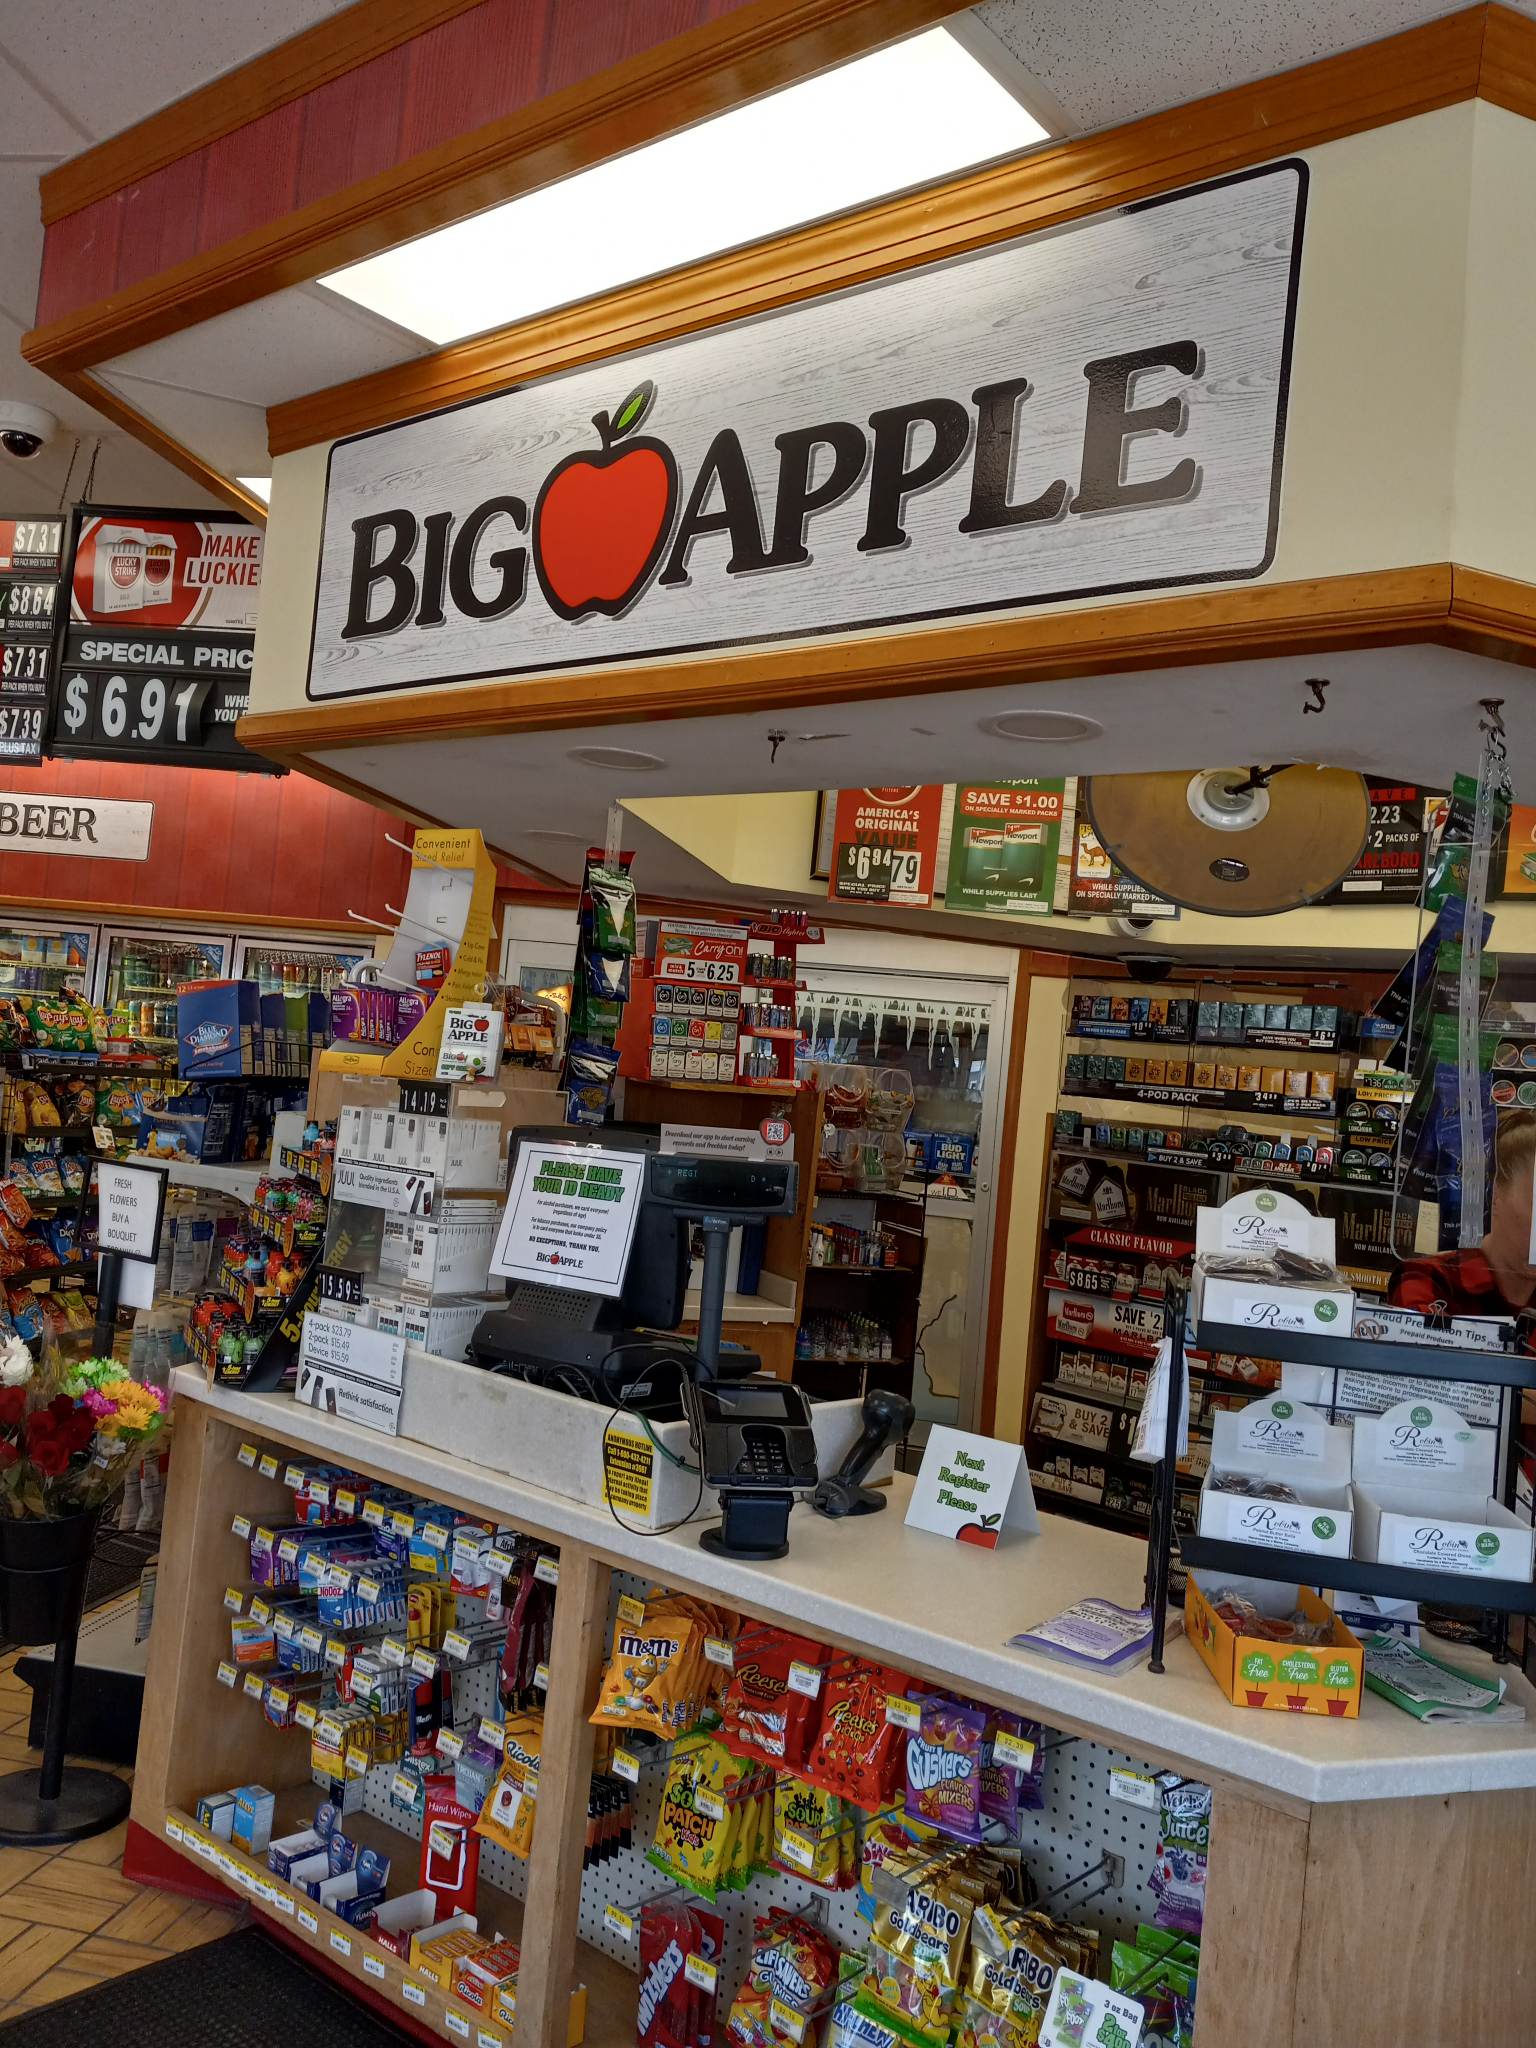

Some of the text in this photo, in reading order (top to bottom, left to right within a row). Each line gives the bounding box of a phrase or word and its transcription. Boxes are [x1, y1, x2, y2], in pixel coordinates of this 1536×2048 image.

[341, 340, 1204, 643] BIG APPLE
[15, 522, 61, 553] $7.31
[203, 535, 261, 559] MAKE
[116, 556, 137, 567] LUCKY
[115, 566, 137, 577] STRIKE
[186, 561, 262, 586] LUCKIE
[9, 585, 55, 615] $8.64
[2, 648, 48, 678] $7.31
[80, 641, 252, 670] SPECIAL PRIC
[64, 674, 198, 742] $6.91
[224, 695, 249, 708] WHE
[20, 742, 36, 754] TAX
[967, 791, 1058, 809] SAVE $1.00
[857, 807, 920, 820] AMERICA'S
[976, 806, 1009, 814] SPECIALLY
[855, 818, 919, 832] ORIGINAL
[415, 837, 471, 850] Convenient
[855, 832, 918, 849] VALUE
[1385, 833, 1409, 843] PACKS
[440, 852, 465, 862] Relief
[963, 888, 1038, 899] WHILE SUPPLIES LAST
[1076, 890, 1150, 901] ON SPECIALLY MARKED
[1092, 883, 1113, 891] WHILE
[694, 940, 726, 960] Carry
[687, 961, 696, 978] 5
[449, 1017, 473, 1030] BIG
[447, 1029, 489, 1043] APPLE
[1137, 1089, 1199, 1103] 4-POD PACK
[936, 1150, 966, 1160] LIGHT
[941, 1143, 963, 1152] BUD
[1158, 1154, 1173, 1163] BUY
[1173, 1155, 1179, 1163] 2
[1179, 1156, 1185, 1164] &
[1185, 1157, 1203, 1166] SAVE
[540, 1160, 624, 1185] PLEASE HAVE
[114, 1177, 132, 1190] FRESH
[532, 1176, 626, 1203] YOUR ID READY
[109, 1194, 138, 1207] FLOWERS
[112, 1212, 130, 1224] BUY A
[1232, 1215, 1281, 1236] Robin
[107, 1228, 137, 1242] BOUQUET
[1090, 1230, 1174, 1255] CLASSIC FLAVOR
[1353, 1242, 1367, 1250] NOW
[536, 1252, 584, 1269] BIG APPLE
[1114, 1305, 1146, 1327] SAVE
[1244, 1302, 1297, 1328] Robin
[1373, 1311, 1487, 1342] Fraud Tips
[1400, 1327, 1425, 1341] Prepaid
[308, 1342, 329, 1358] Device
[338, 1388, 360, 1403] Rethink
[1341, 1390, 1376, 1403] incident of
[1343, 1383, 1366, 1394] Report
[1340, 1396, 1382, 1412] transactions
[1074, 1408, 1108, 1426] BUY 2
[1068, 1418, 1111, 1438] & SAVE
[1249, 1419, 1298, 1440] Robin
[1389, 1425, 1436, 1448] Robin
[608, 1433, 634, 1447] ANONYMOUS
[954, 1450, 986, 1472] Next
[937, 1466, 991, 1493] Register
[936, 1488, 978, 1513] Please
[1240, 1505, 1293, 1531] Robin
[1408, 1527, 1460, 1551] Robin
[1247, 1663, 1269, 1678] Free
[1282, 1659, 1317, 1670] CHOLESTEROL
[1330, 1665, 1349, 1673] GLUTEN
[1287, 1667, 1309, 1681] Free
[1328, 1672, 1349, 1685] Free
[917, 1736, 937, 1750] FRUIT
[940, 1778, 971, 1795] FLAVOR
[938, 1791, 976, 1812] MIXERS
[428, 1801, 472, 1820] Hand Wipes
[786, 1801, 824, 1827] SOUR
[664, 1801, 717, 1841] PATCH
[907, 1889, 961, 1937] ARIBO
[889, 1911, 951, 1955] Goldbears
[377, 1936, 398, 1953] HALLS
[418, 1966, 440, 1984] HALLS
[457, 1982, 484, 2006] Ricola
[1104, 1999, 1139, 2024] 3 oz Bag
[1104, 2012, 1117, 2029] 2
